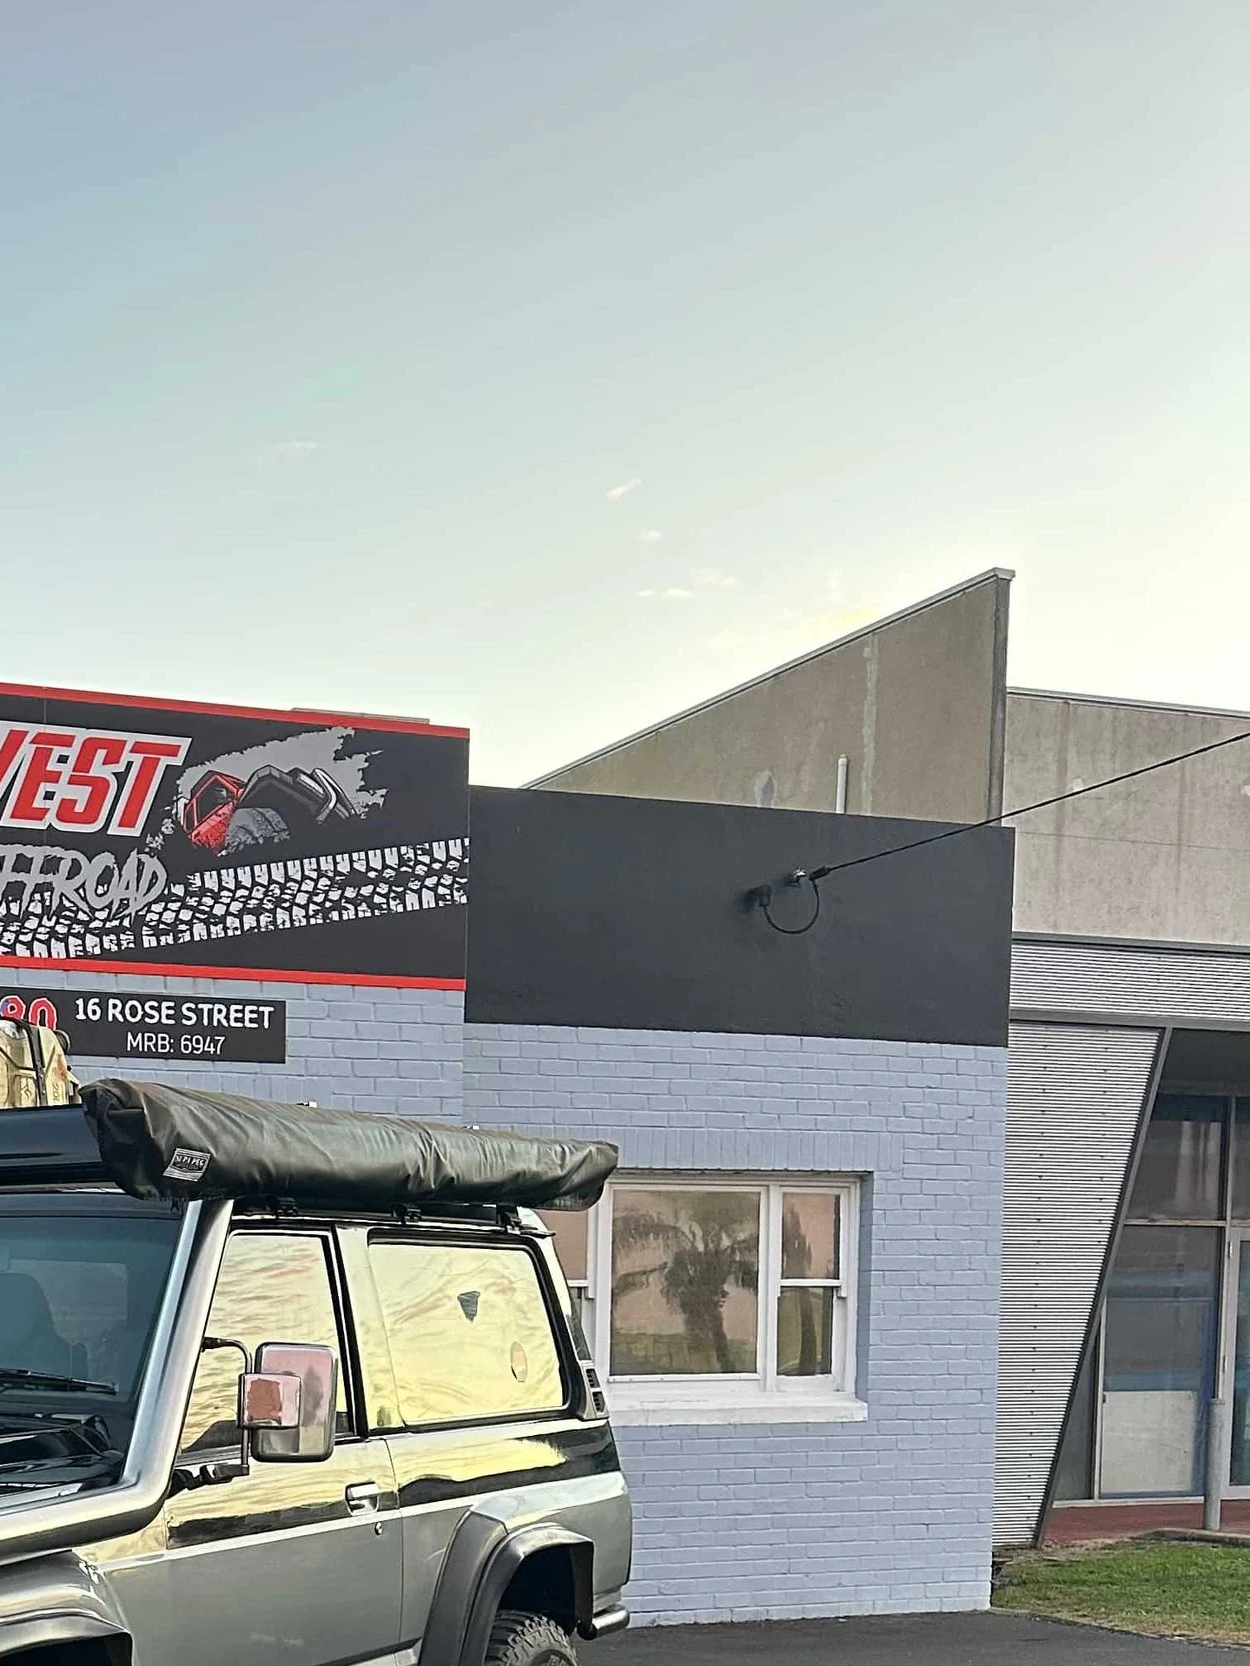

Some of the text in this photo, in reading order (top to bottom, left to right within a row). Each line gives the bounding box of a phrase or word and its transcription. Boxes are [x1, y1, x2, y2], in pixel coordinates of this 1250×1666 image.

[75, 998, 275, 1029] 16 ROSE STREET
[126, 1032, 225, 1055] MRB: 6947
